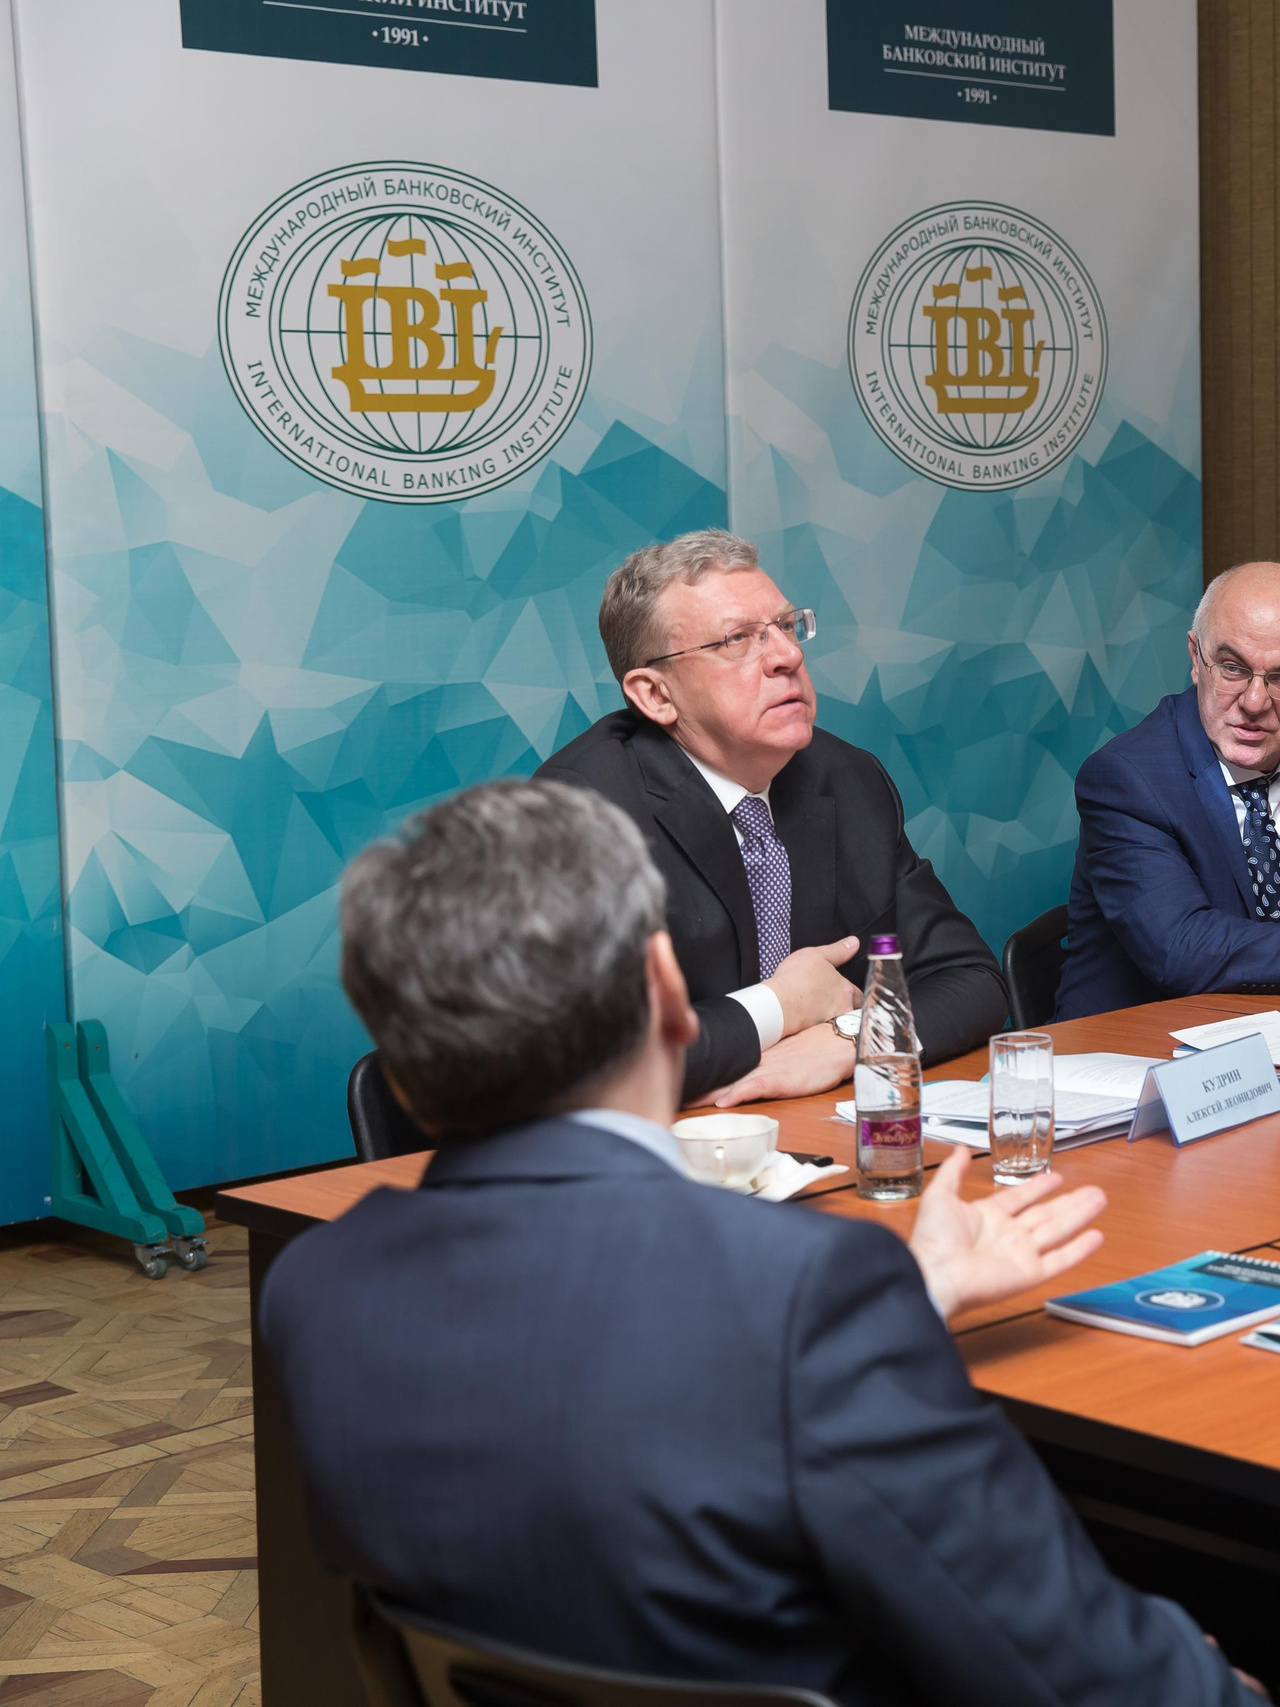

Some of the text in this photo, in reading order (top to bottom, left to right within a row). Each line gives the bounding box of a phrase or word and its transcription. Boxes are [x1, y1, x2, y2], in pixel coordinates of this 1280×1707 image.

[882, 44, 1066, 82] БАНКОВСКИЙ ИНСТИТУТ
[904, 24, 1045, 56] МЕЖДУНАРОДНЫЙ
[246, 177, 571, 328] МЕЖДУНАРОДНЫЙ БАНКОВСКИЙ ИНСТИТУТ
[865, 214, 1094, 341] МЕЖДУНАРОДНЫЙ БАНКОВСКИЙ ИНСТИТУТ
[247, 360, 573, 489] INTERNATIONAL BANKING INSTITUTE
[866, 370, 1094, 479] INTERNATIONAL BANKING INSTITUTE
[1186, 1082, 1273, 1125] АЛЕКСЕЙ ЛЕОНИДОВИЧ
[1201, 1068, 1242, 1094] КУДРИН
